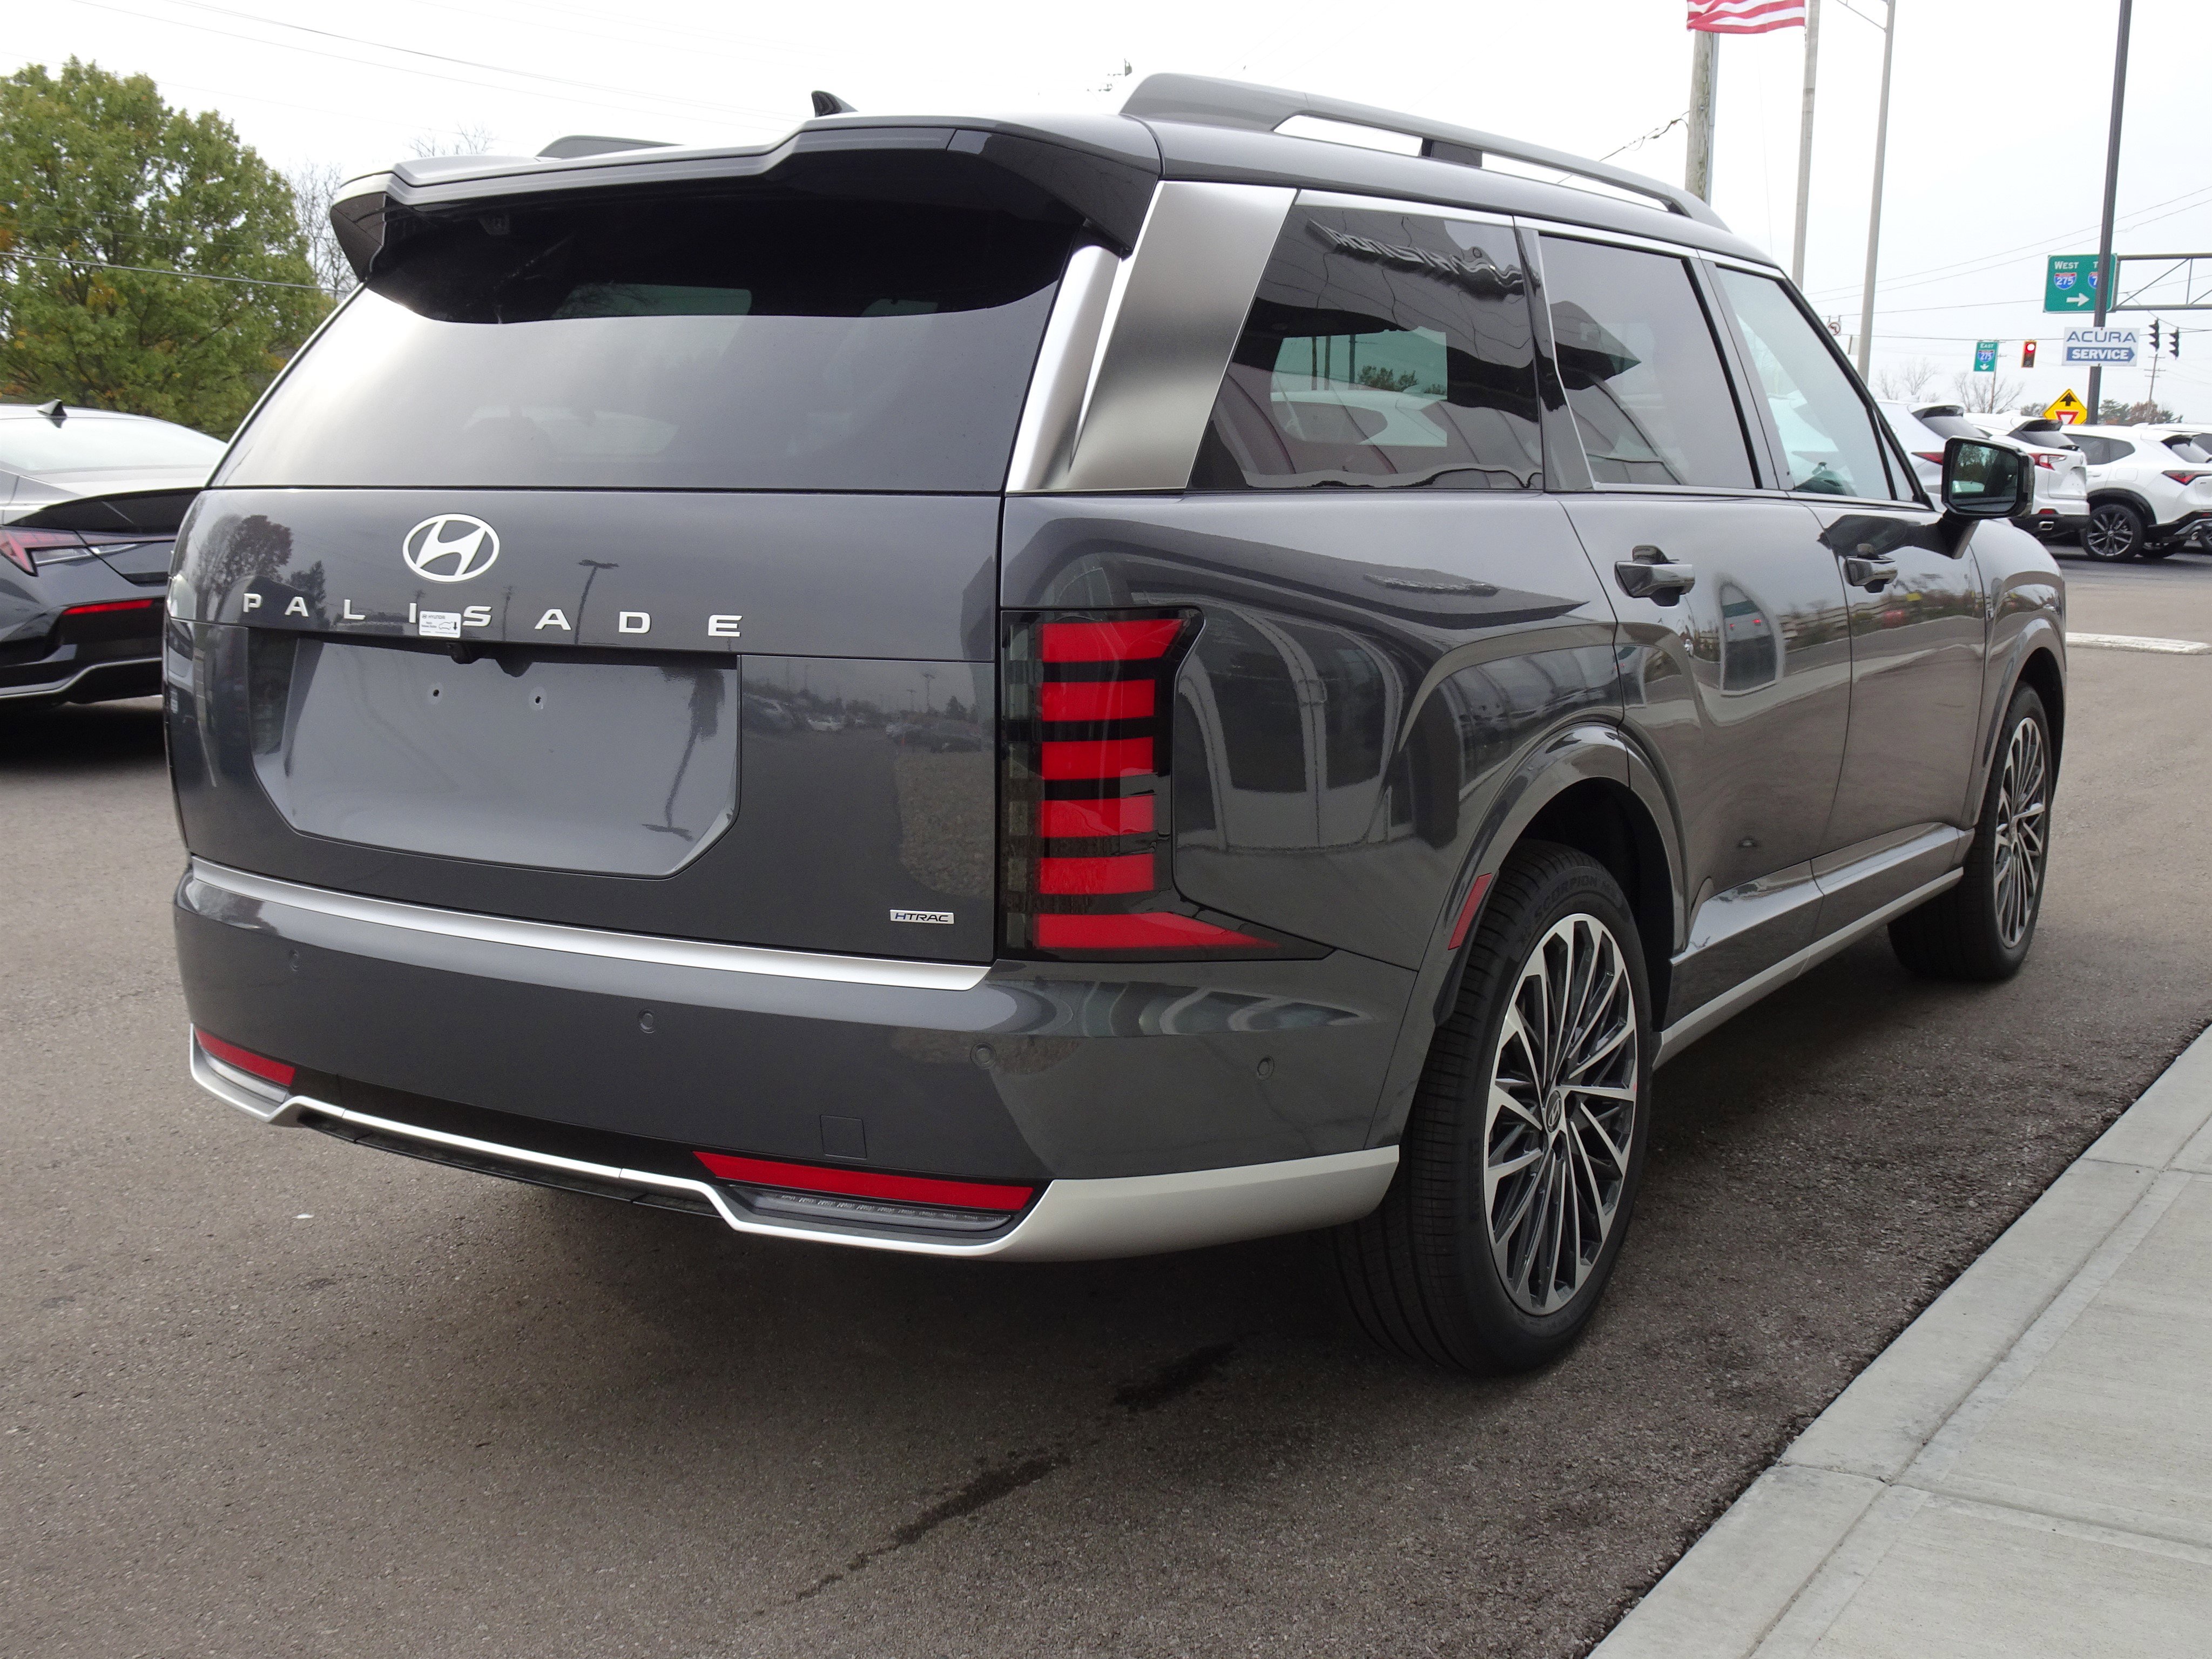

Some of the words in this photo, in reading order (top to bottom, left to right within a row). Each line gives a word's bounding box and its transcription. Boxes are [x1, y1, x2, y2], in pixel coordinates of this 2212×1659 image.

[2054, 261, 2079, 269] WEST
[2056, 276, 2074, 285] 275
[2066, 331, 2136, 342] ACURA
[1980, 352, 1992, 360] 275
[2072, 349, 2129, 360] SERVICE
[243, 592, 743, 638] PALISADE
[895, 913, 949, 922] HTRAC
